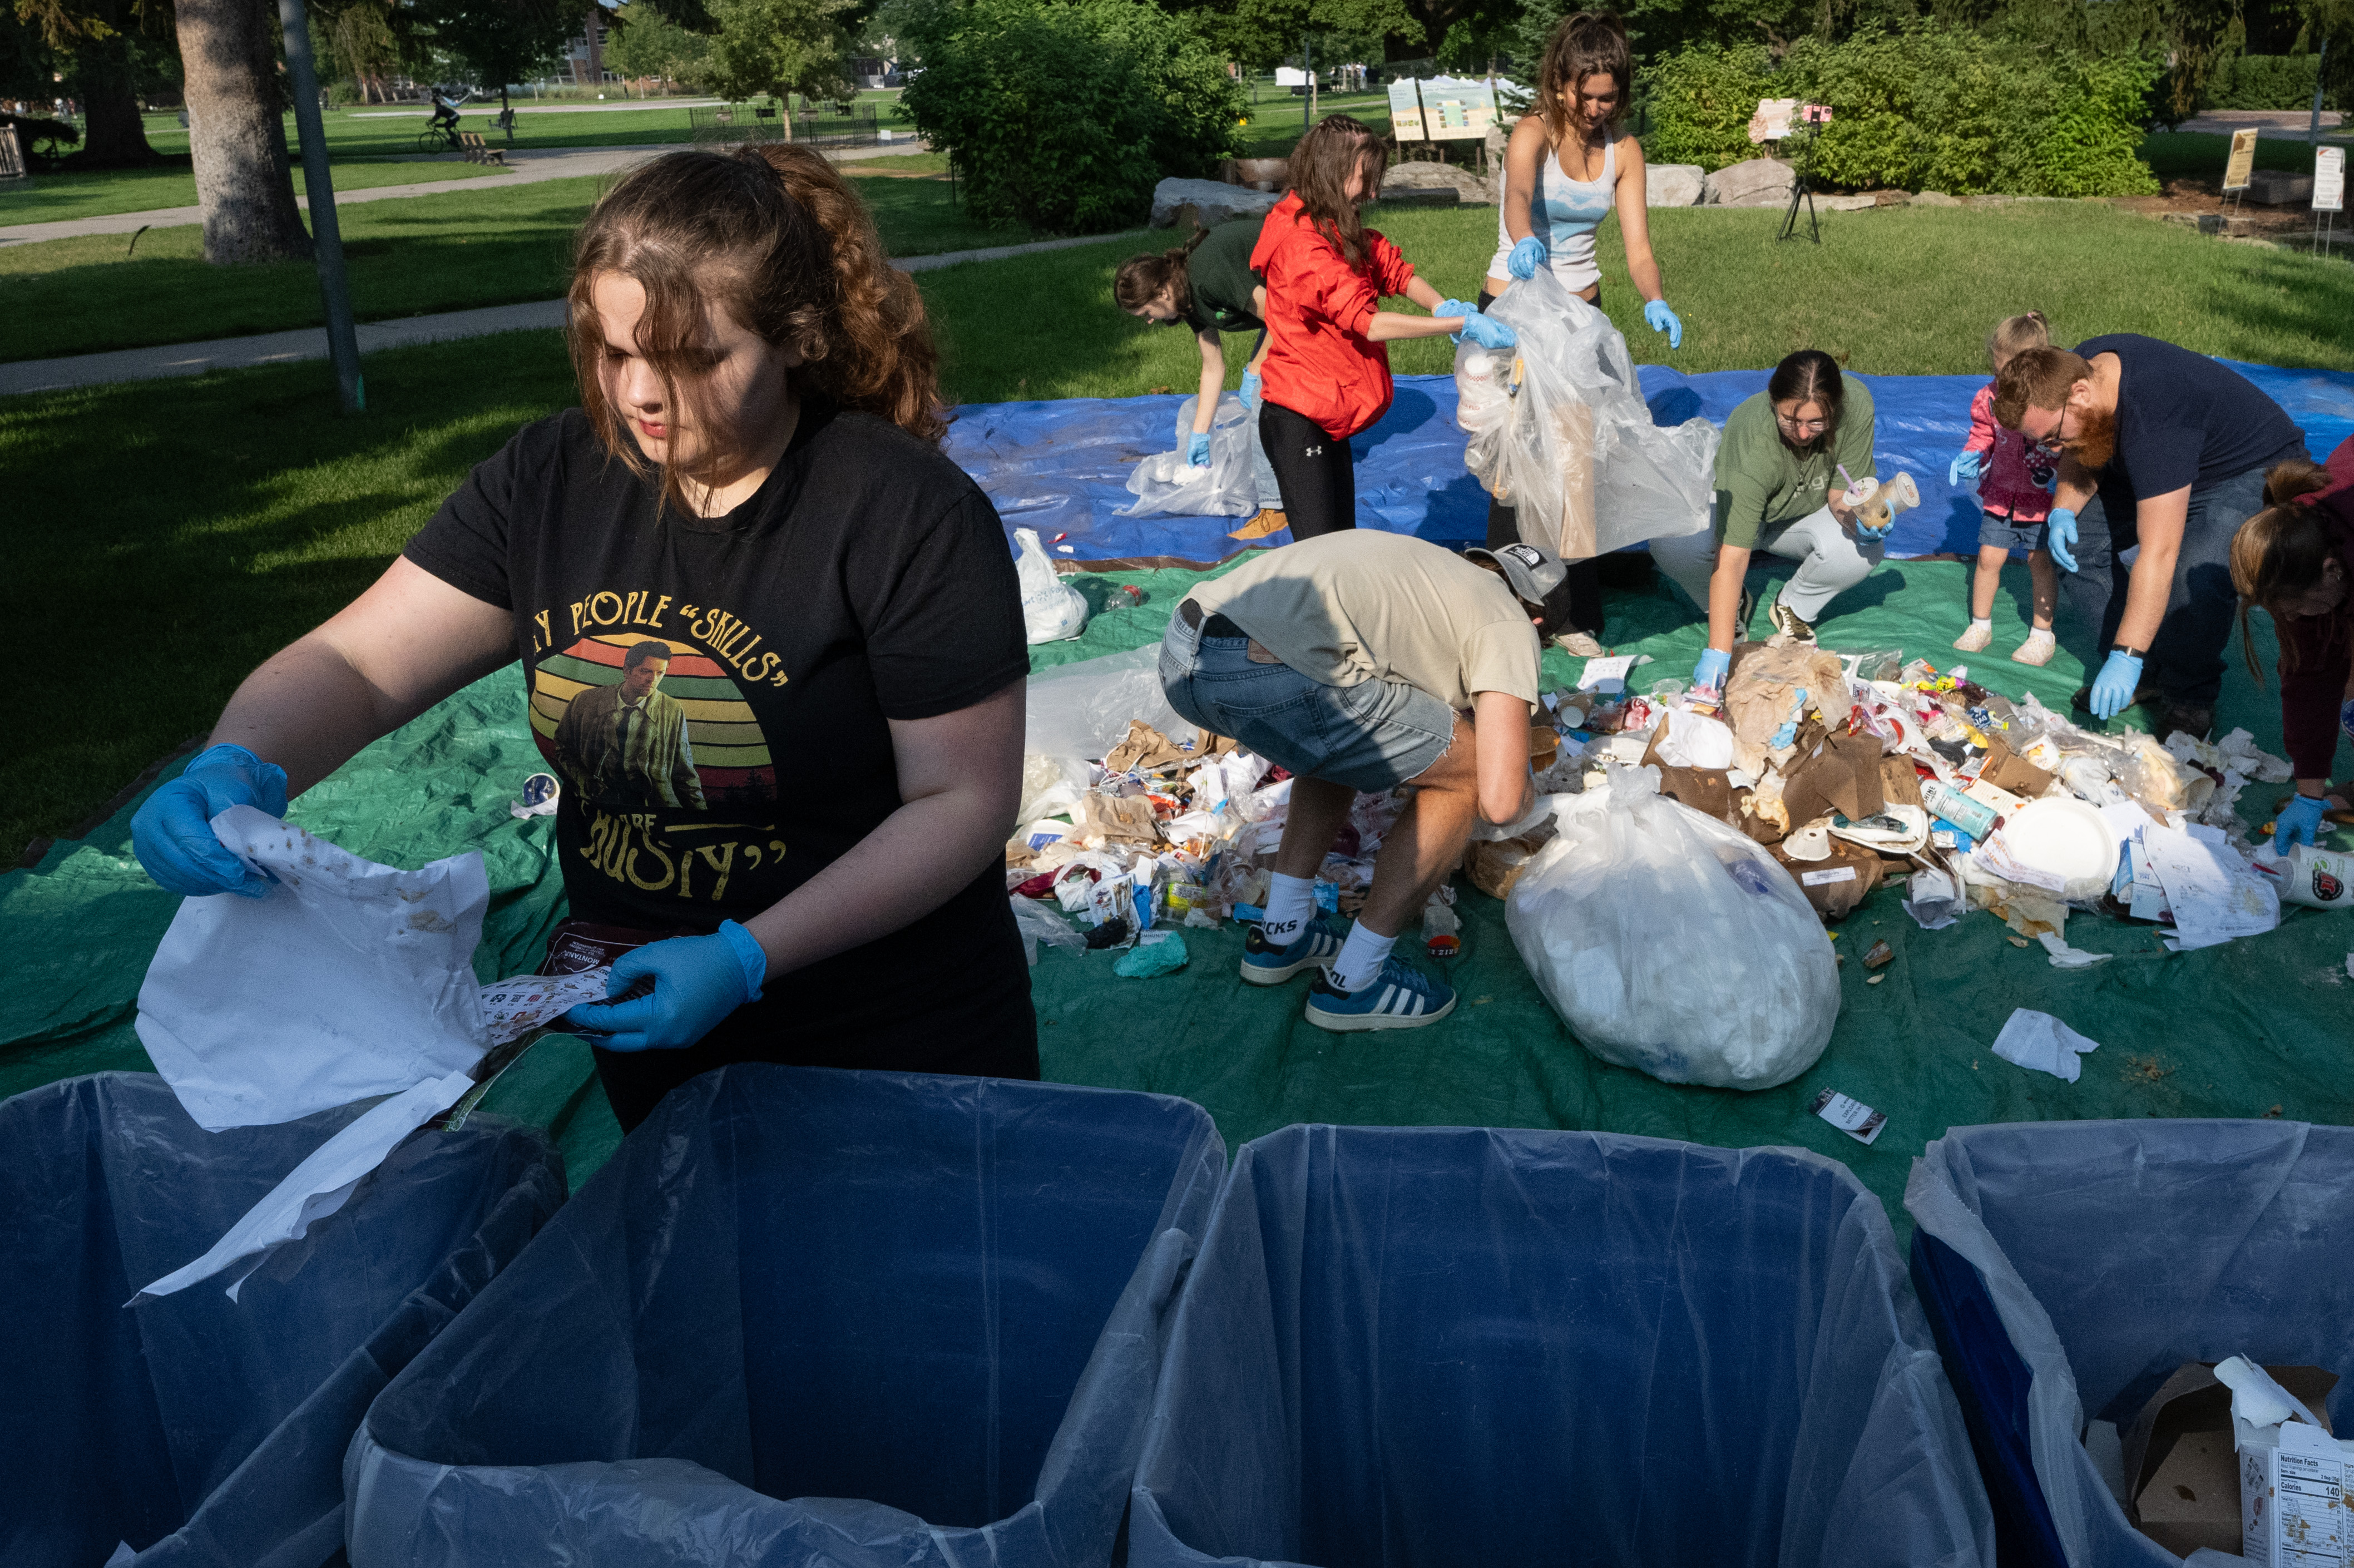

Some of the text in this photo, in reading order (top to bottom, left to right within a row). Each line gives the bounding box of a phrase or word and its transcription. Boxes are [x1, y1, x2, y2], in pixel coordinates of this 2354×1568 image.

[570, 591, 672, 636] PEOPLE
[563, 950, 600, 965] MONTANA
[2281, 1455, 2318, 1467] Nutrition Facts
[2281, 1482, 2340, 1497] Calories 140
